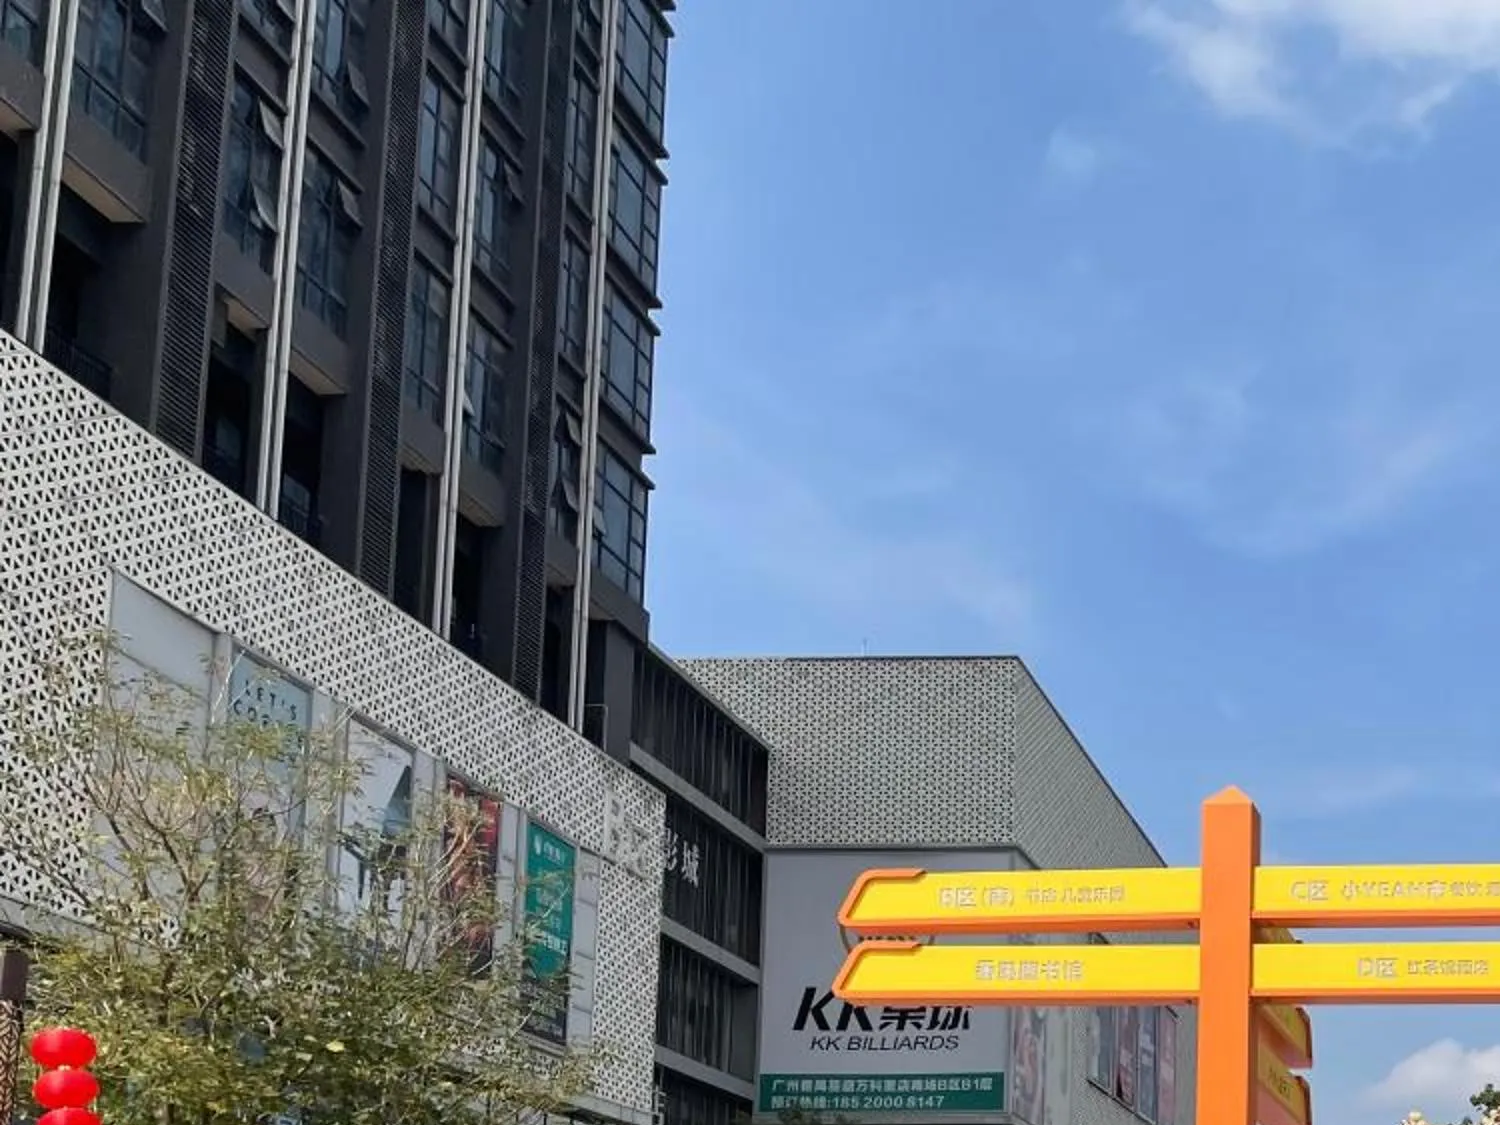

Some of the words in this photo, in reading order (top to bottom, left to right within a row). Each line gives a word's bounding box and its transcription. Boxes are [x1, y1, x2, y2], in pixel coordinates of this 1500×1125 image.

[810, 1035, 841, 1051] KK
[847, 1034, 960, 1051] BILLIARDS
[864, 1095, 904, 1108] 2000
